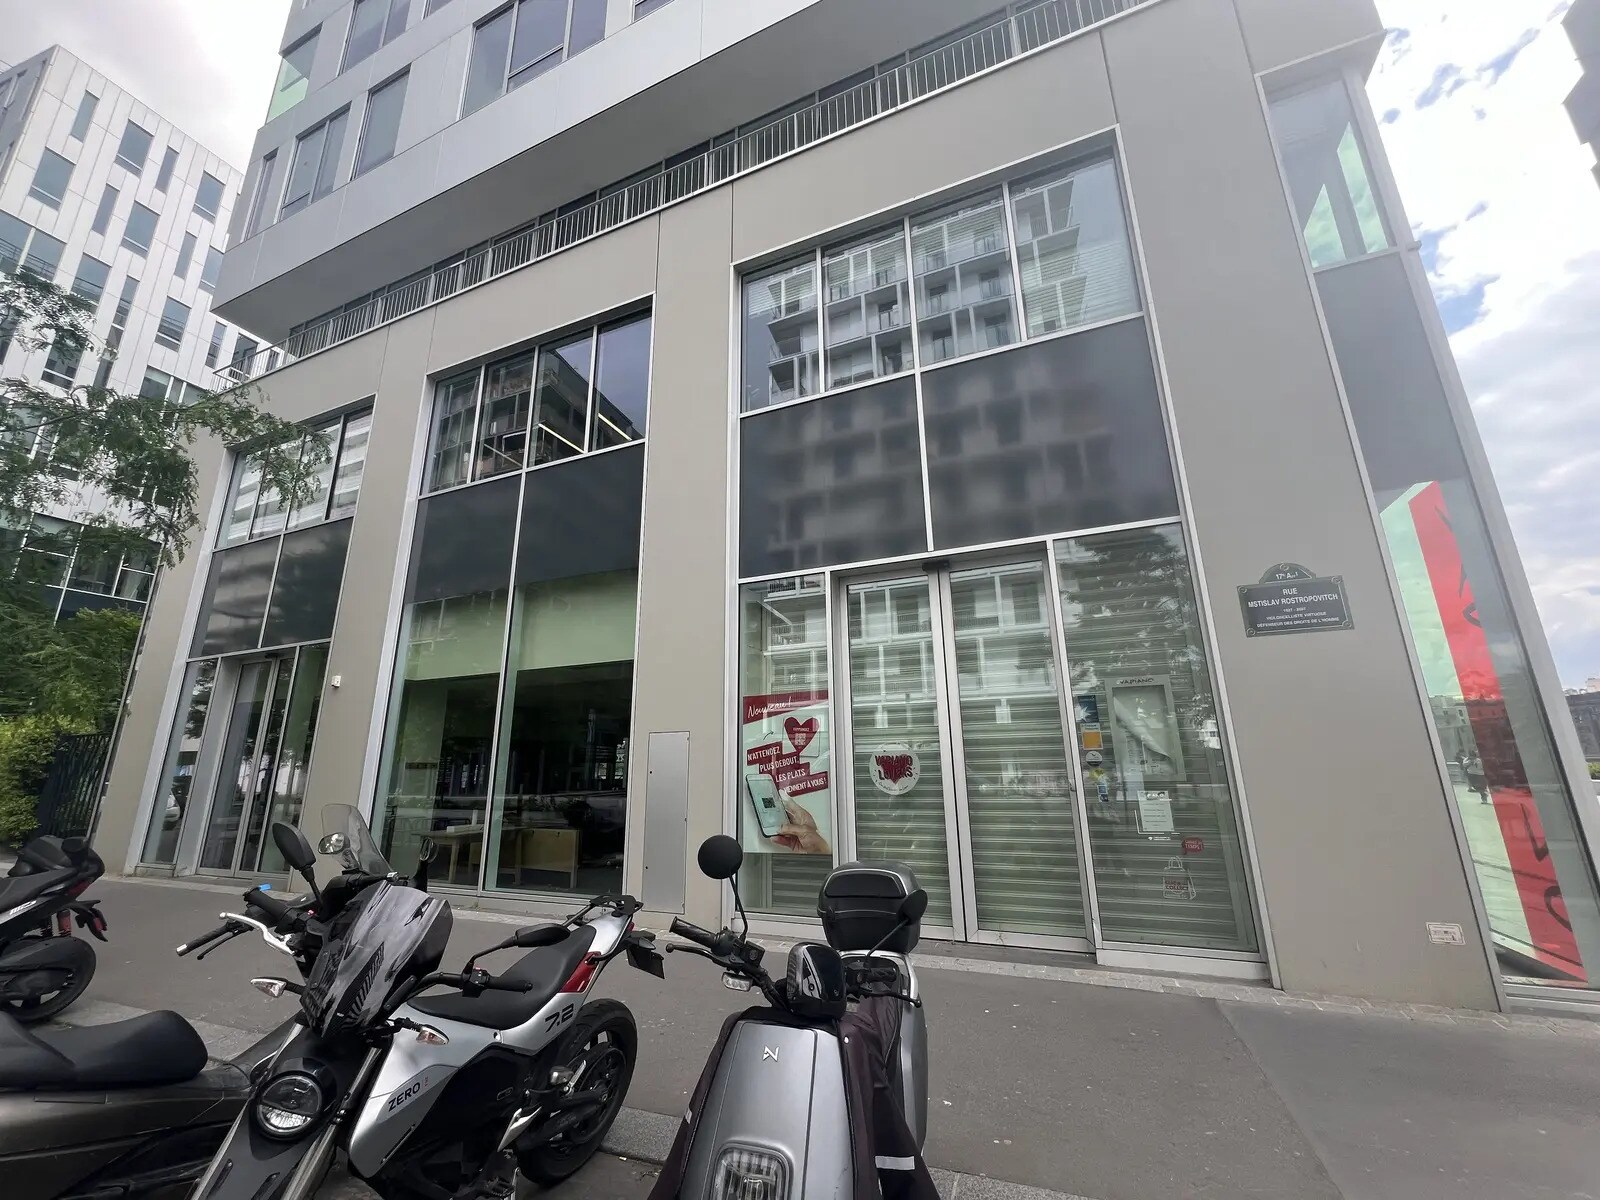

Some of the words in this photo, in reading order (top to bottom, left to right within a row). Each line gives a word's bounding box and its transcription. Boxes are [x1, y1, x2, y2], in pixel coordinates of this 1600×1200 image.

[1282, 587, 1298, 596] RUE
[1248, 598, 1280, 608] MSTISLAV
[1281, 593, 1339, 605] ROSTROPOVITCH
[748, 746, 780, 761] N'ATTENDEZ
[760, 761, 775, 773] PLUS
[775, 773, 788, 783] LES
[787, 768, 806, 780] PLATS
[544, 1003, 575, 1034] 7.2
[388, 1081, 421, 1113] ZERO
